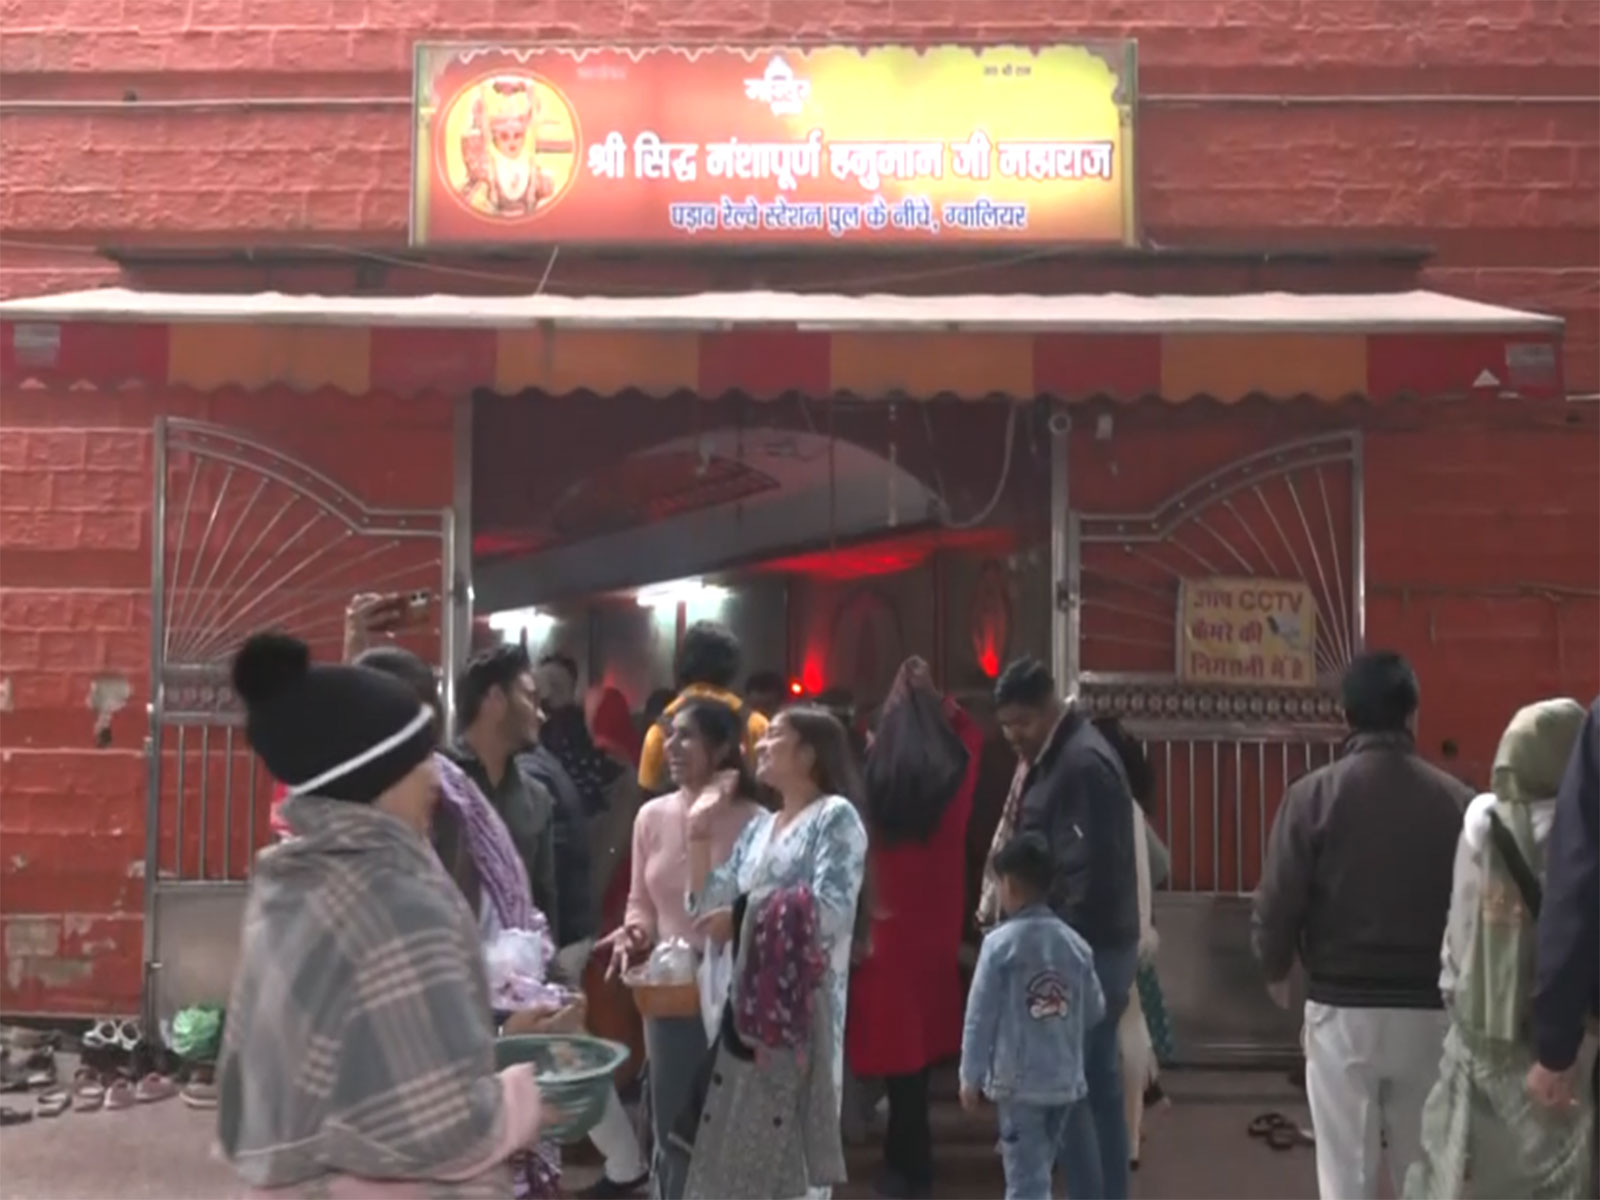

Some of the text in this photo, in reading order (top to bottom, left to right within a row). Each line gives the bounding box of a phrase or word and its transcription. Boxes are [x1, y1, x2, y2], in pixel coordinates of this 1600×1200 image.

[587, 129, 1112, 190] श्री सिद्ध मंशापूर्ण हनुमान जी महाराज
[764, 196, 822, 229] स्टेशन
[828, 203, 860, 237] पुल
[866, 197, 888, 228] के
[944, 198, 1027, 229] ग्वालियर
[1238, 589, 1304, 613] CCTV
[1239, 619, 1263, 644] की
